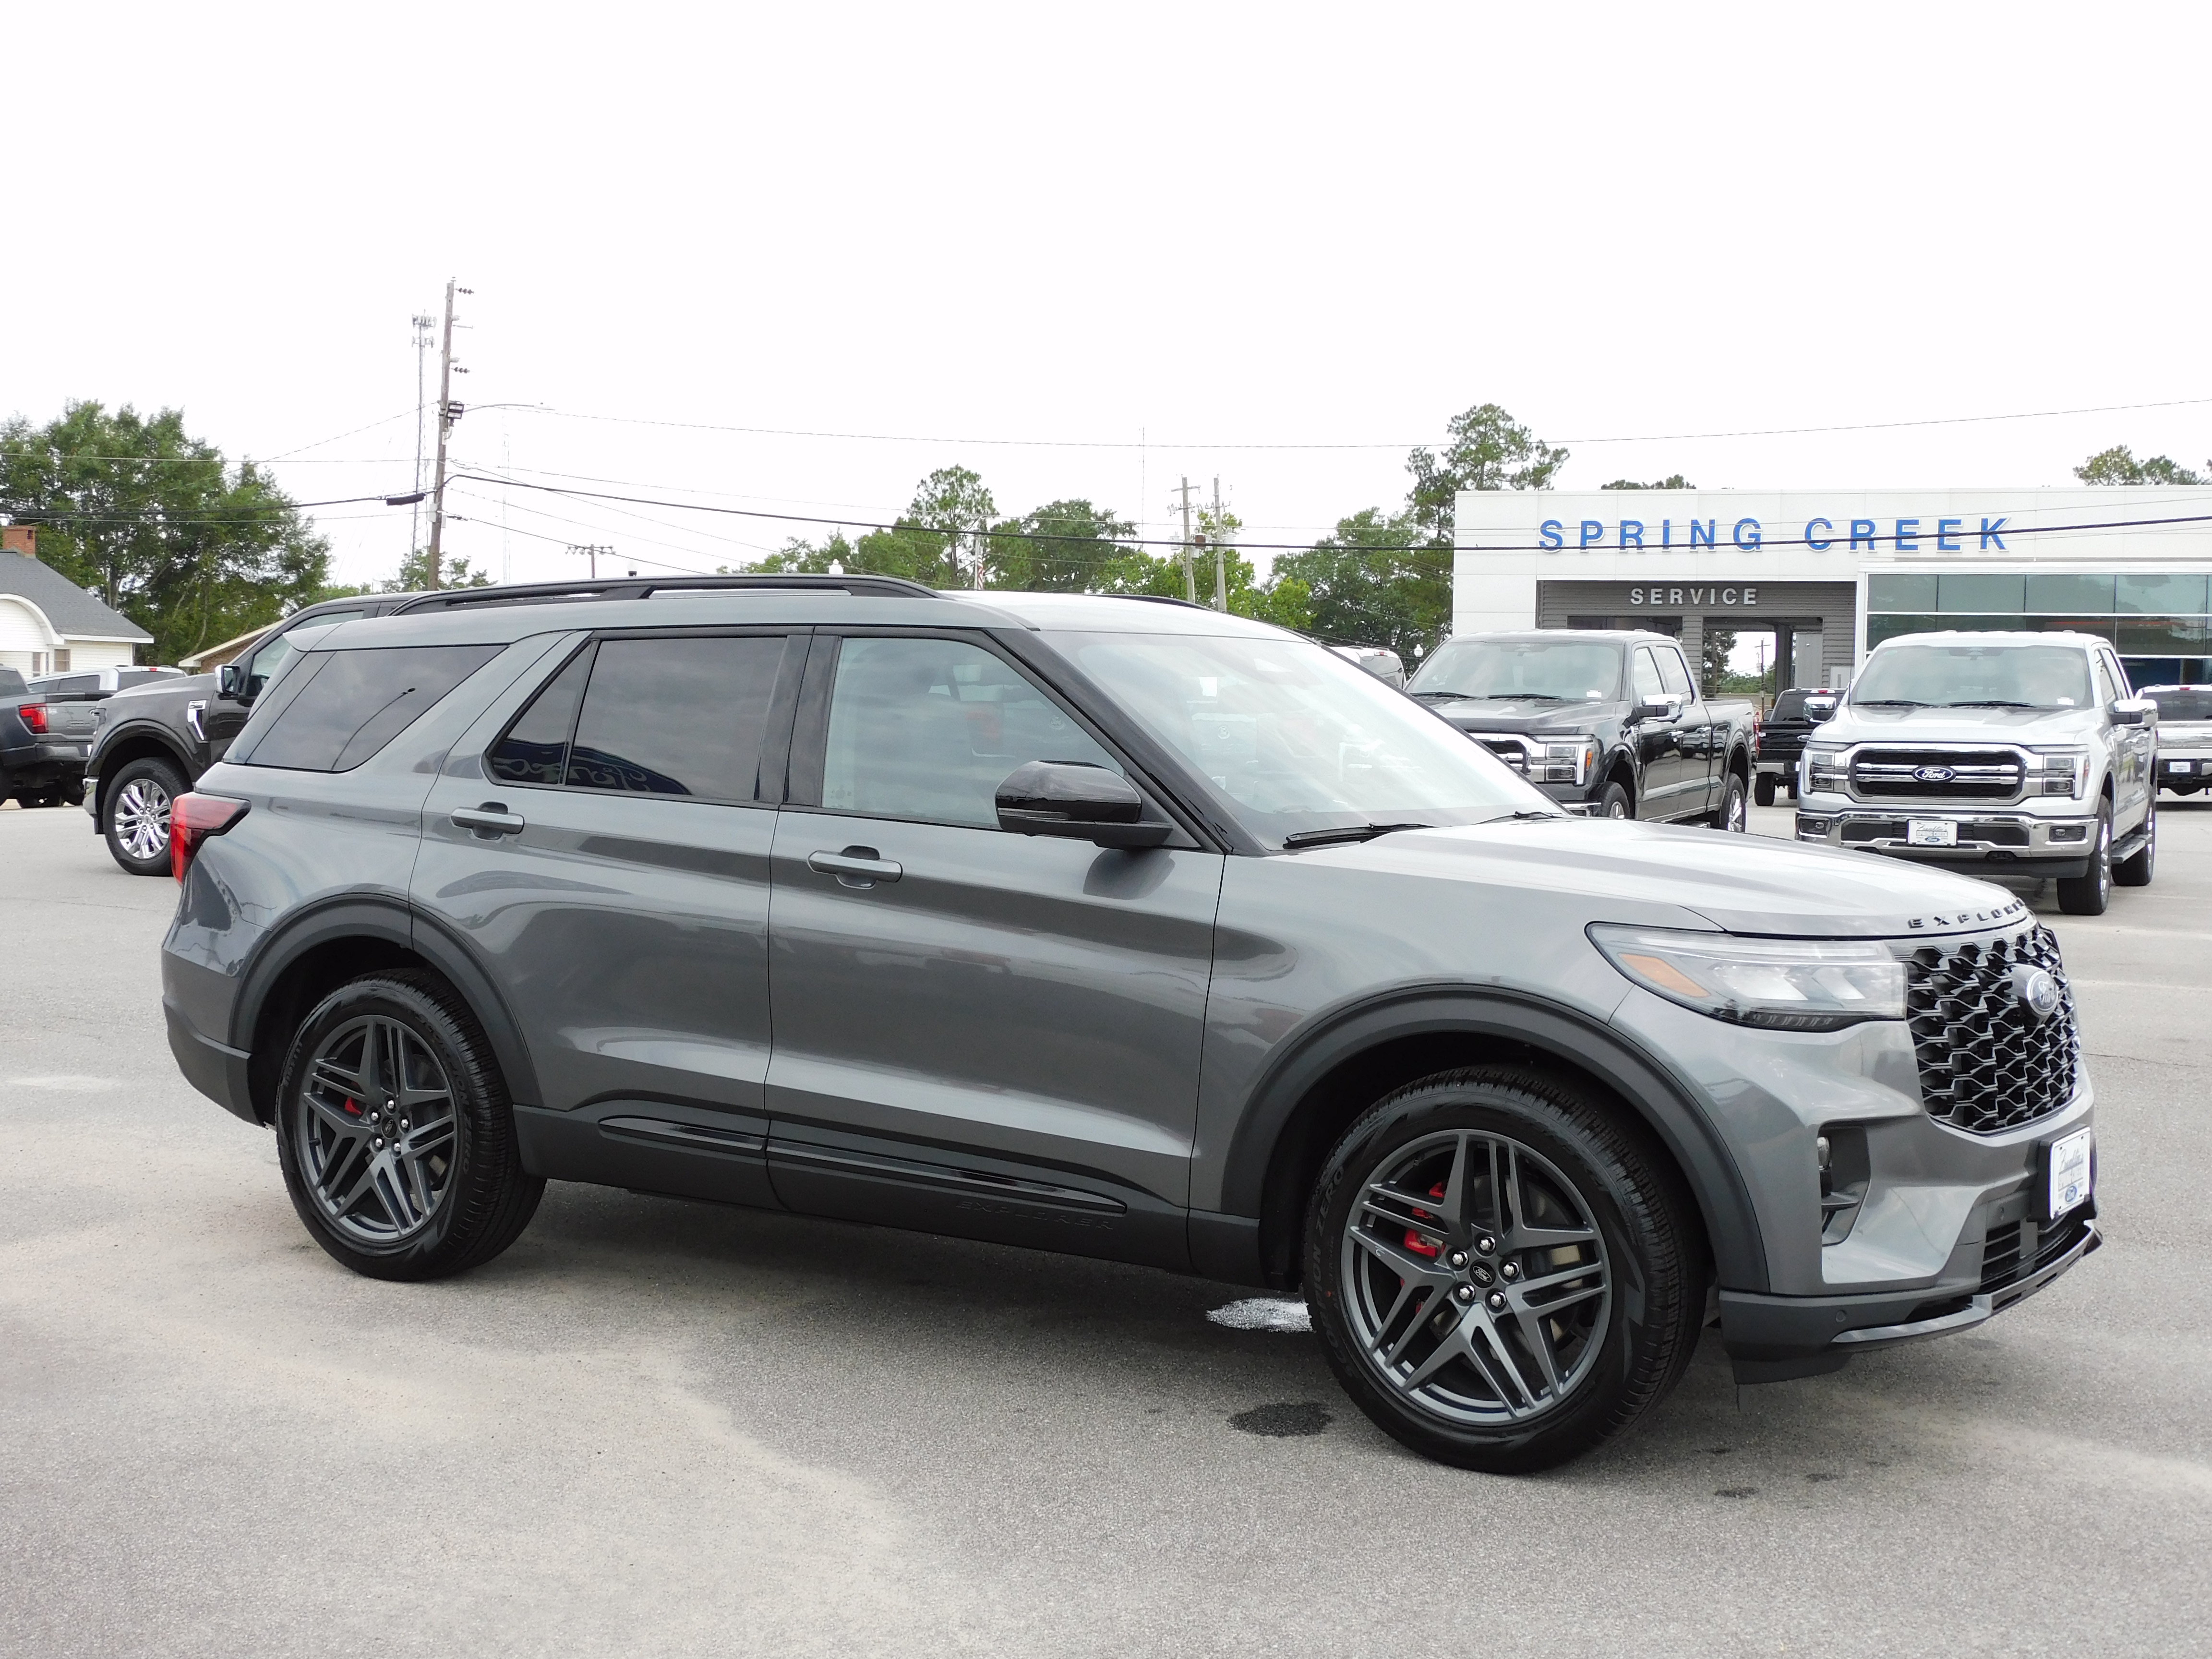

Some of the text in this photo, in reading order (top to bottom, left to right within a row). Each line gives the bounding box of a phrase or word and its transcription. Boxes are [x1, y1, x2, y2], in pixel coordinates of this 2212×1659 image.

[1538, 517, 2011, 553] SPRING CREEK
[1630, 588, 1757, 605] SERVICE
[1907, 897, 2025, 929] EXPLOR
[956, 1201, 1114, 1230] EXPLORER
[1316, 1166, 1345, 1237] ZERO
